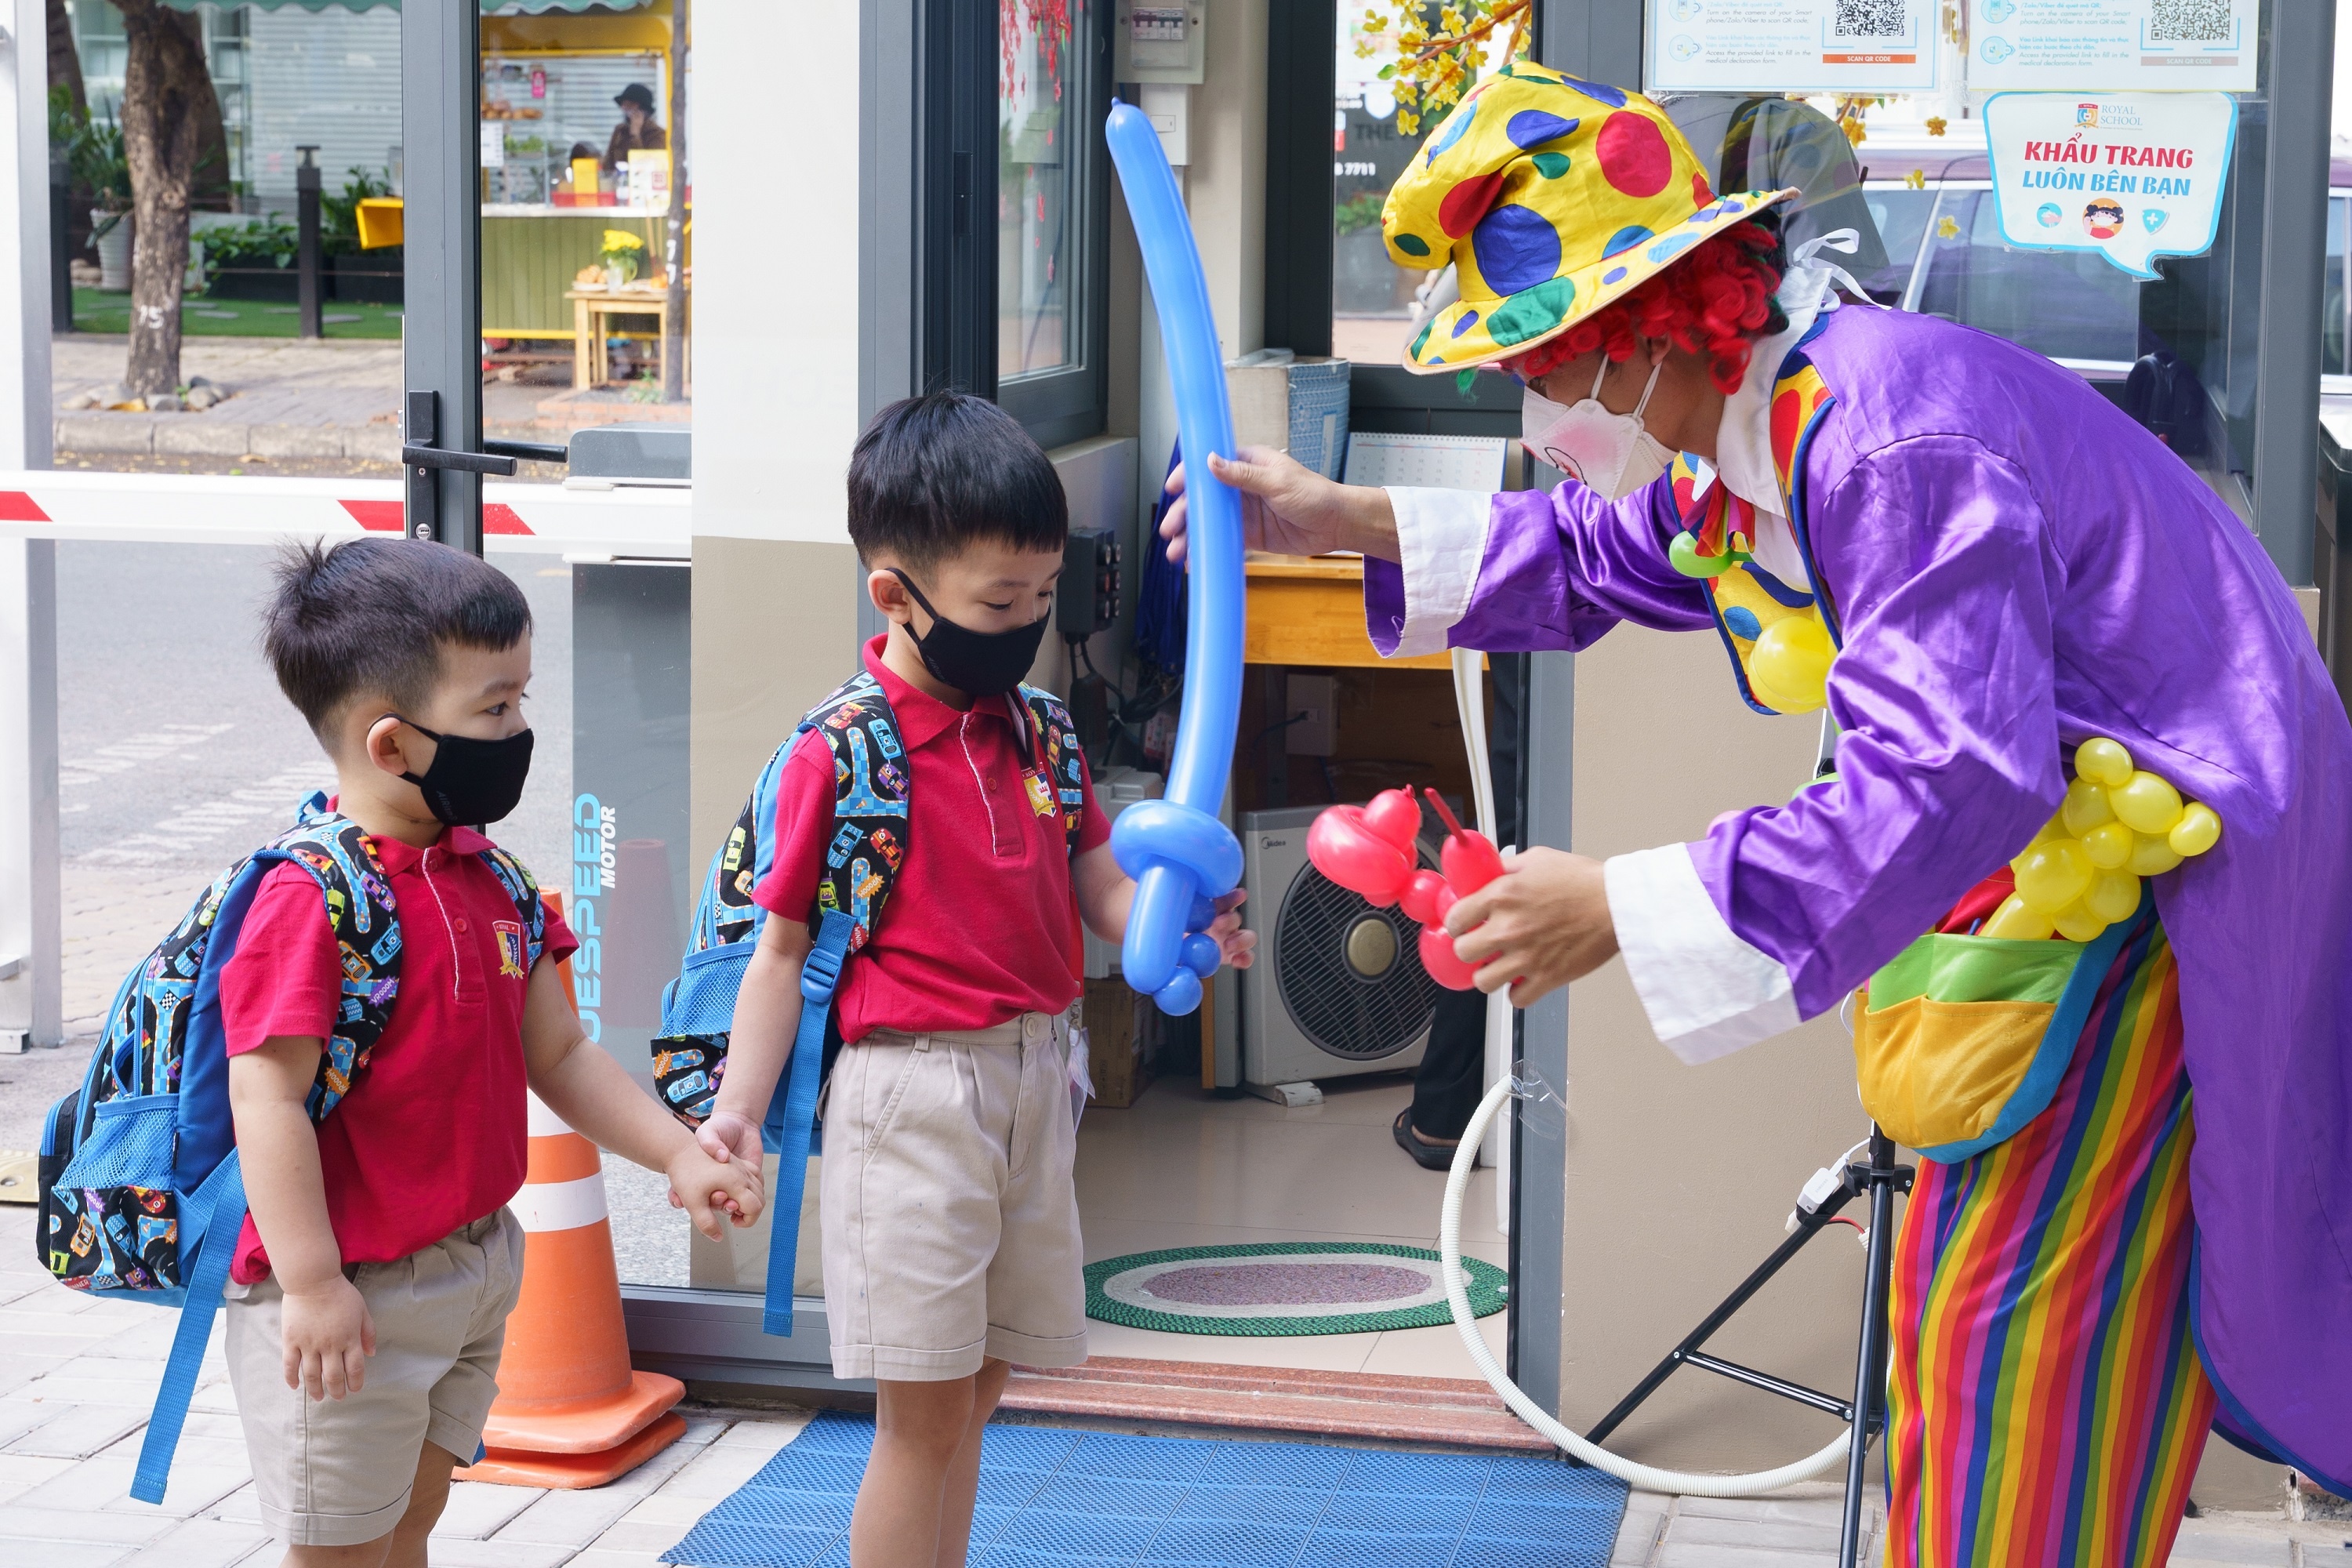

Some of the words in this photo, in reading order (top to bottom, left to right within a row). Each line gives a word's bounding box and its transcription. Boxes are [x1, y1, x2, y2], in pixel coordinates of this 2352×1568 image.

[2100, 115, 2143, 125] SCHOOL
[2102, 104, 2136, 114] ROYAL
[1354, 124, 1393, 140] THE
[2024, 132, 2098, 164] KHẨU
[2104, 145, 2194, 169] TRANG
[2022, 166, 2085, 191] LUÔN
[2090, 169, 2137, 193] BÊN
[2142, 176, 2190, 199] BẠN
[601, 806, 615, 888] MOTOR
[370, 978, 394, 1004] VROOOM
